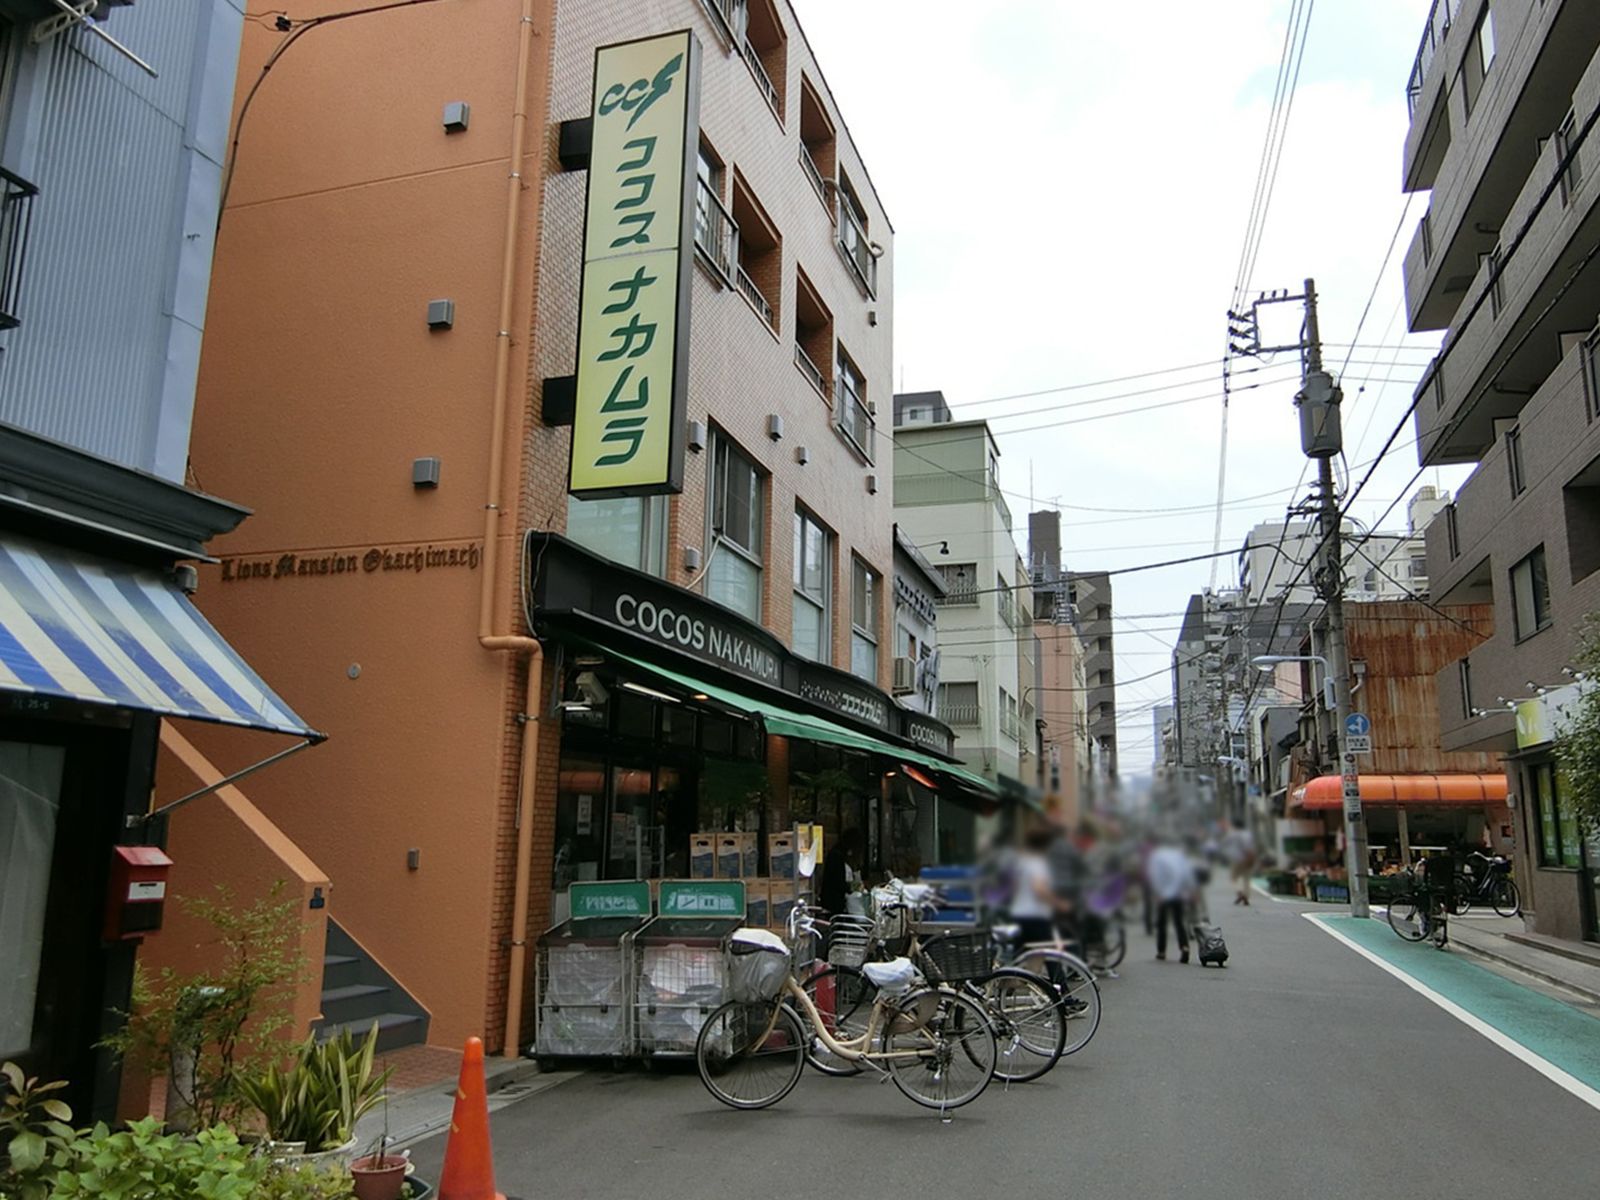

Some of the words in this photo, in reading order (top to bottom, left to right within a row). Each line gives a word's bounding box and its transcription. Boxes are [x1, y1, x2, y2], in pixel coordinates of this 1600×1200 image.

[221, 559, 272, 582] Lions
[274, 552, 358, 579] Mansion
[616, 594, 706, 650] COCOS
[708, 626, 779, 681] NAKAMURA
